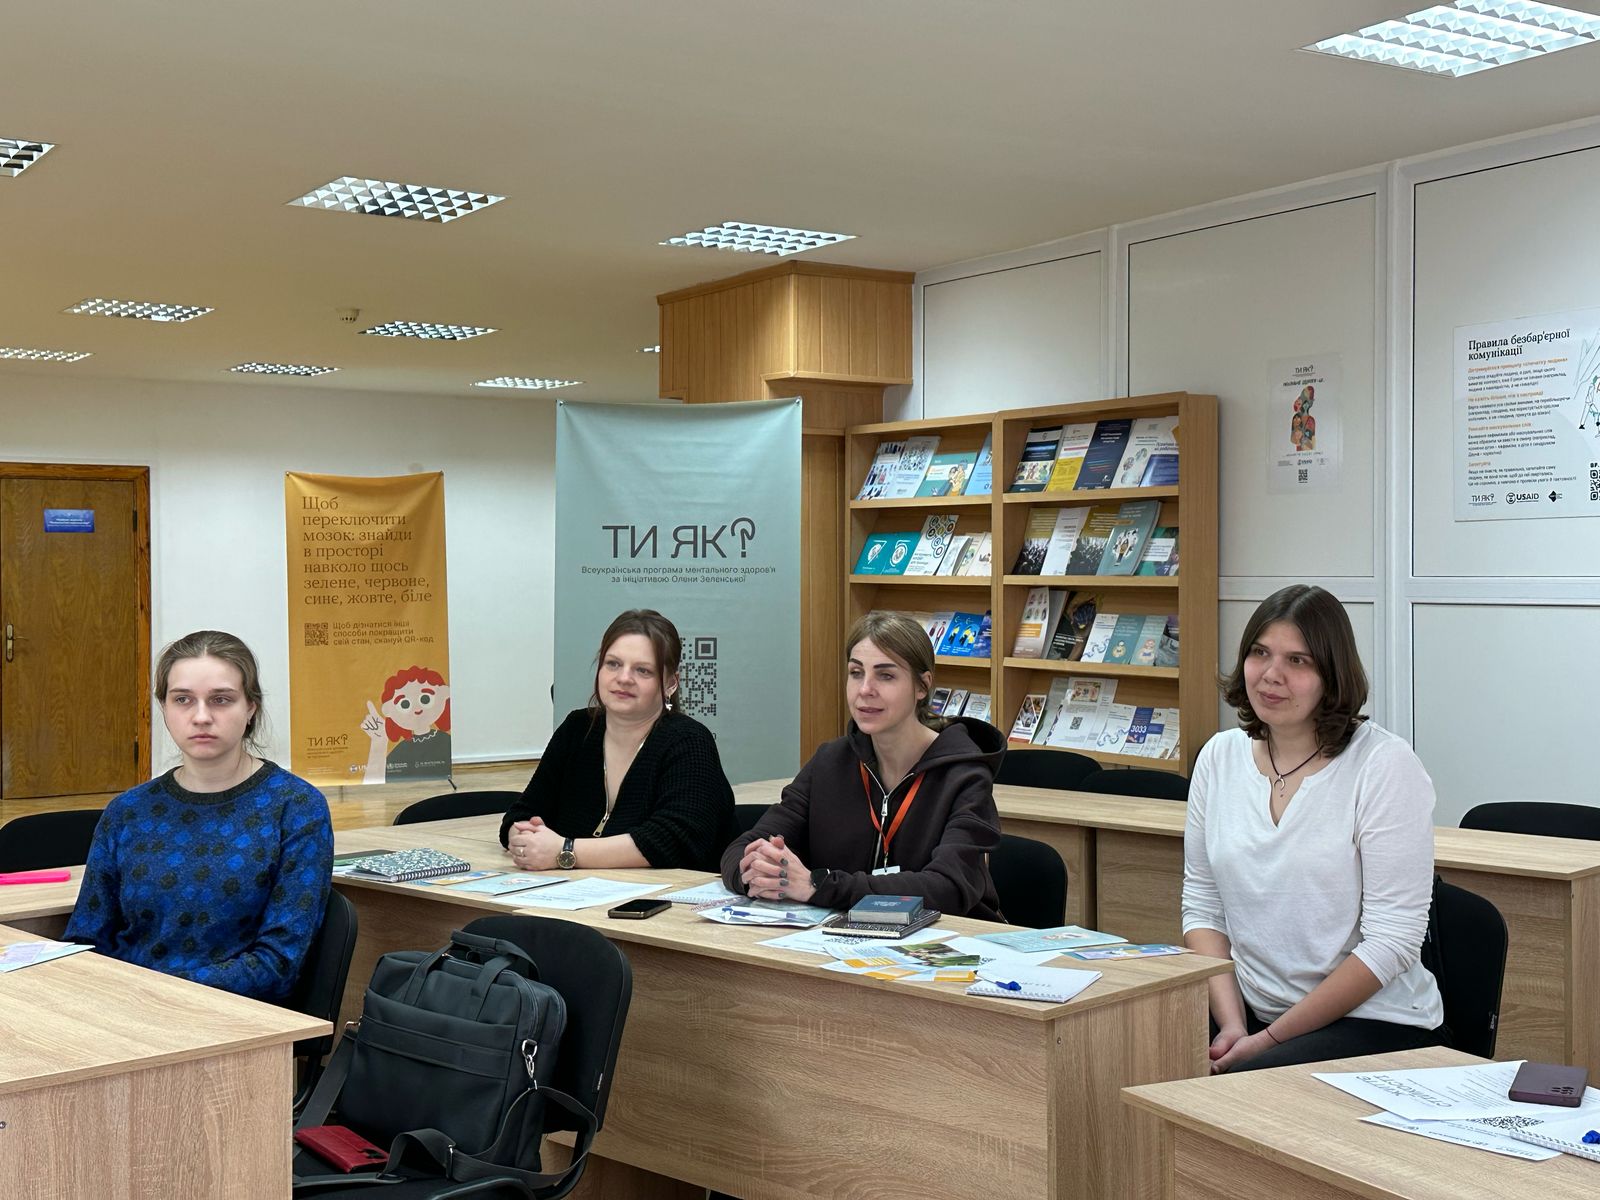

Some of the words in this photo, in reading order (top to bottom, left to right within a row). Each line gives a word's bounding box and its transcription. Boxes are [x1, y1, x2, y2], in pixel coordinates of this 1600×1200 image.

[1468, 339, 1508, 351] Правила
[1511, 328, 1570, 344] безбар'єрної
[1468, 345, 1523, 361] комунікації
[302, 496, 339, 512] Щоб
[302, 515, 407, 528] переключити
[303, 532, 355, 542] мозок:
[359, 528, 412, 542] знайди
[602, 525, 658, 558] ТИ
[670, 517, 756, 558] ЯК?
[304, 548, 311, 557] в
[316, 544, 384, 560] просторі
[304, 563, 366, 573] навколо
[371, 562, 409, 574] щось
[581, 566, 641, 575] Всеукраїнська
[740, 566, 776, 575] здоров'я
[304, 579, 360, 589] зелене,
[365, 577, 430, 590] червоне,
[623, 575, 670, 584] ініціативою
[347, 593, 397, 607] жовте,
[401, 589, 432, 603] біле
[332, 622, 351, 630] Щоб
[333, 630, 367, 638] способи
[369, 628, 414, 636] покращити
[374, 636, 402, 646] скануй
[404, 635, 434, 644] QR-код
[307, 738, 323, 747] ТИ
